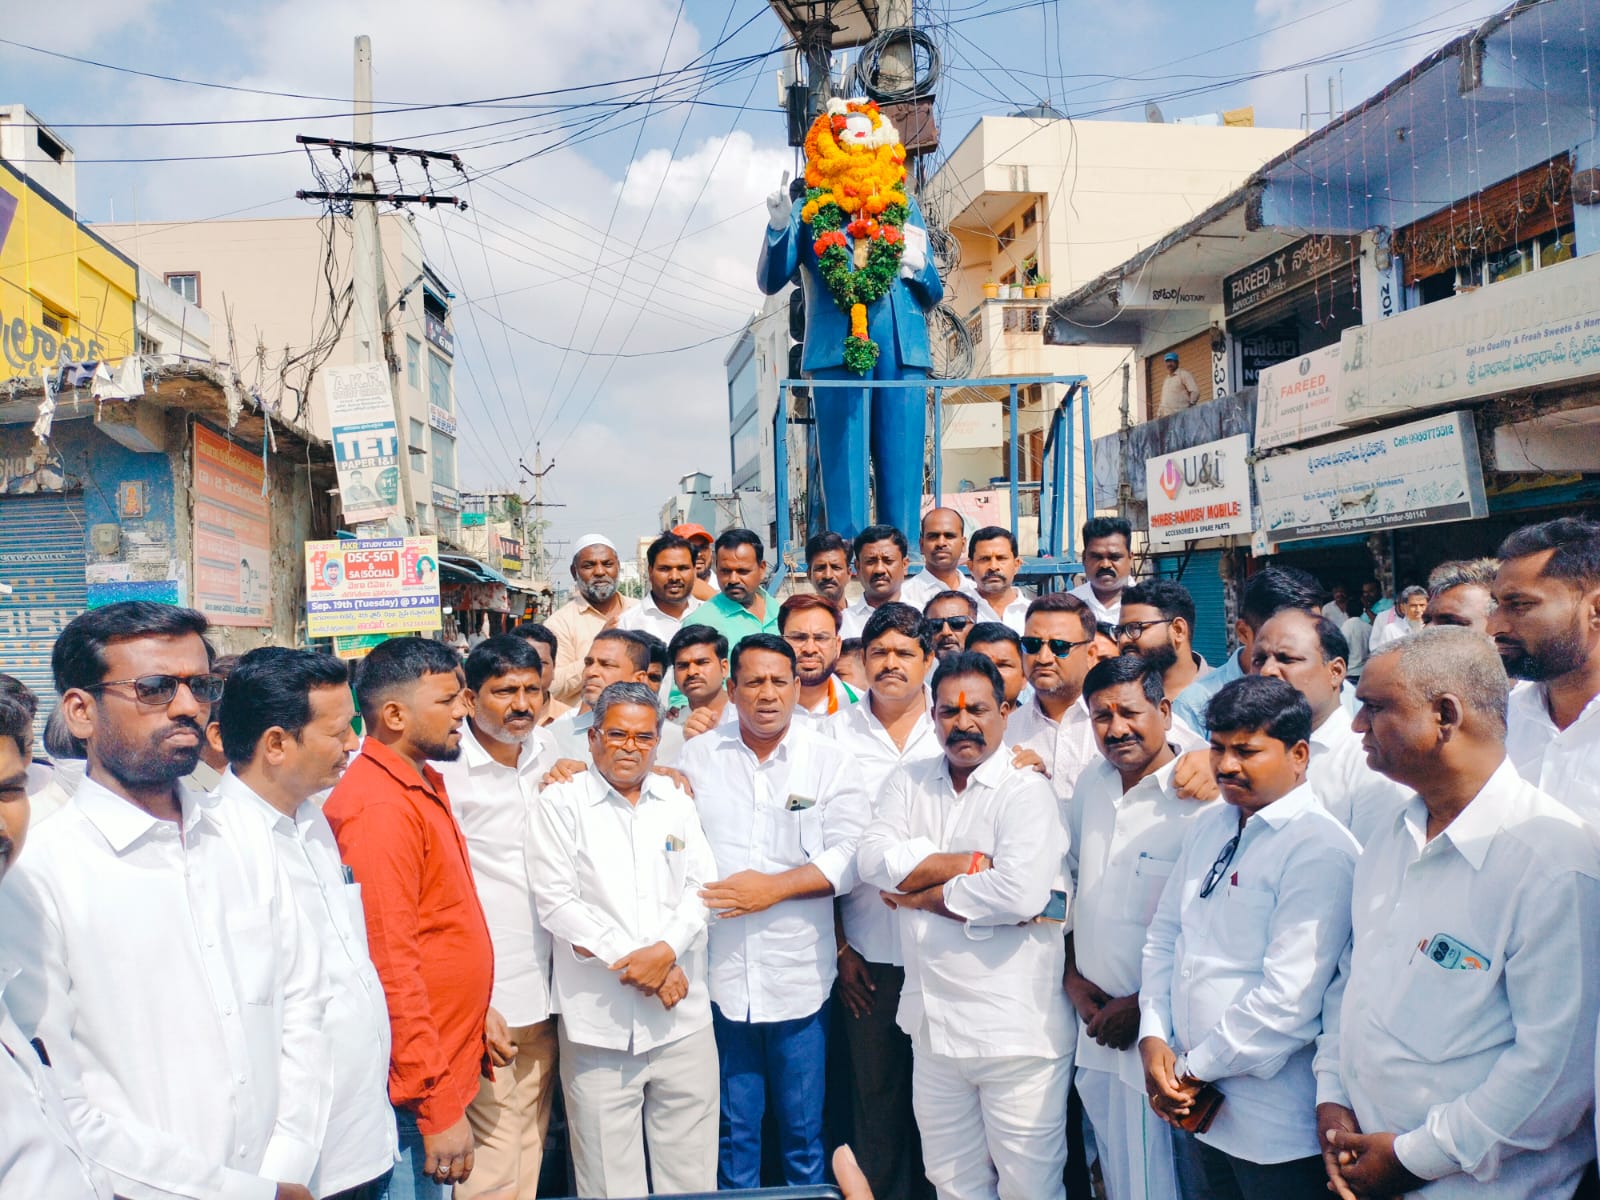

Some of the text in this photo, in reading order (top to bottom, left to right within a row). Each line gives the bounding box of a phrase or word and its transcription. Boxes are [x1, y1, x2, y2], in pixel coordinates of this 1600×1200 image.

[1231, 267, 1271, 299] FAREED
[1486, 339, 1512, 352] Quality
[1521, 332, 1541, 344] Fresh
[1543, 325, 1572, 338] Sweets
[1574, 321, 1581, 330] &
[1280, 374, 1326, 399] FAREED
[336, 428, 398, 461] TET
[342, 458, 376, 470] PAPER
[1207, 501, 1239, 519] MOBILE
[1165, 527, 1194, 537] ACCESSORIES
[1200, 523, 1214, 533] SPARE
[1214, 522, 1230, 530] PARTS
[341, 538, 403, 550] AKR STUDY CIRCLE
[348, 551, 394, 563] DSC-SGT
[311, 596, 435, 611] Sep. 19th (Tuesday) @ 9 AM
